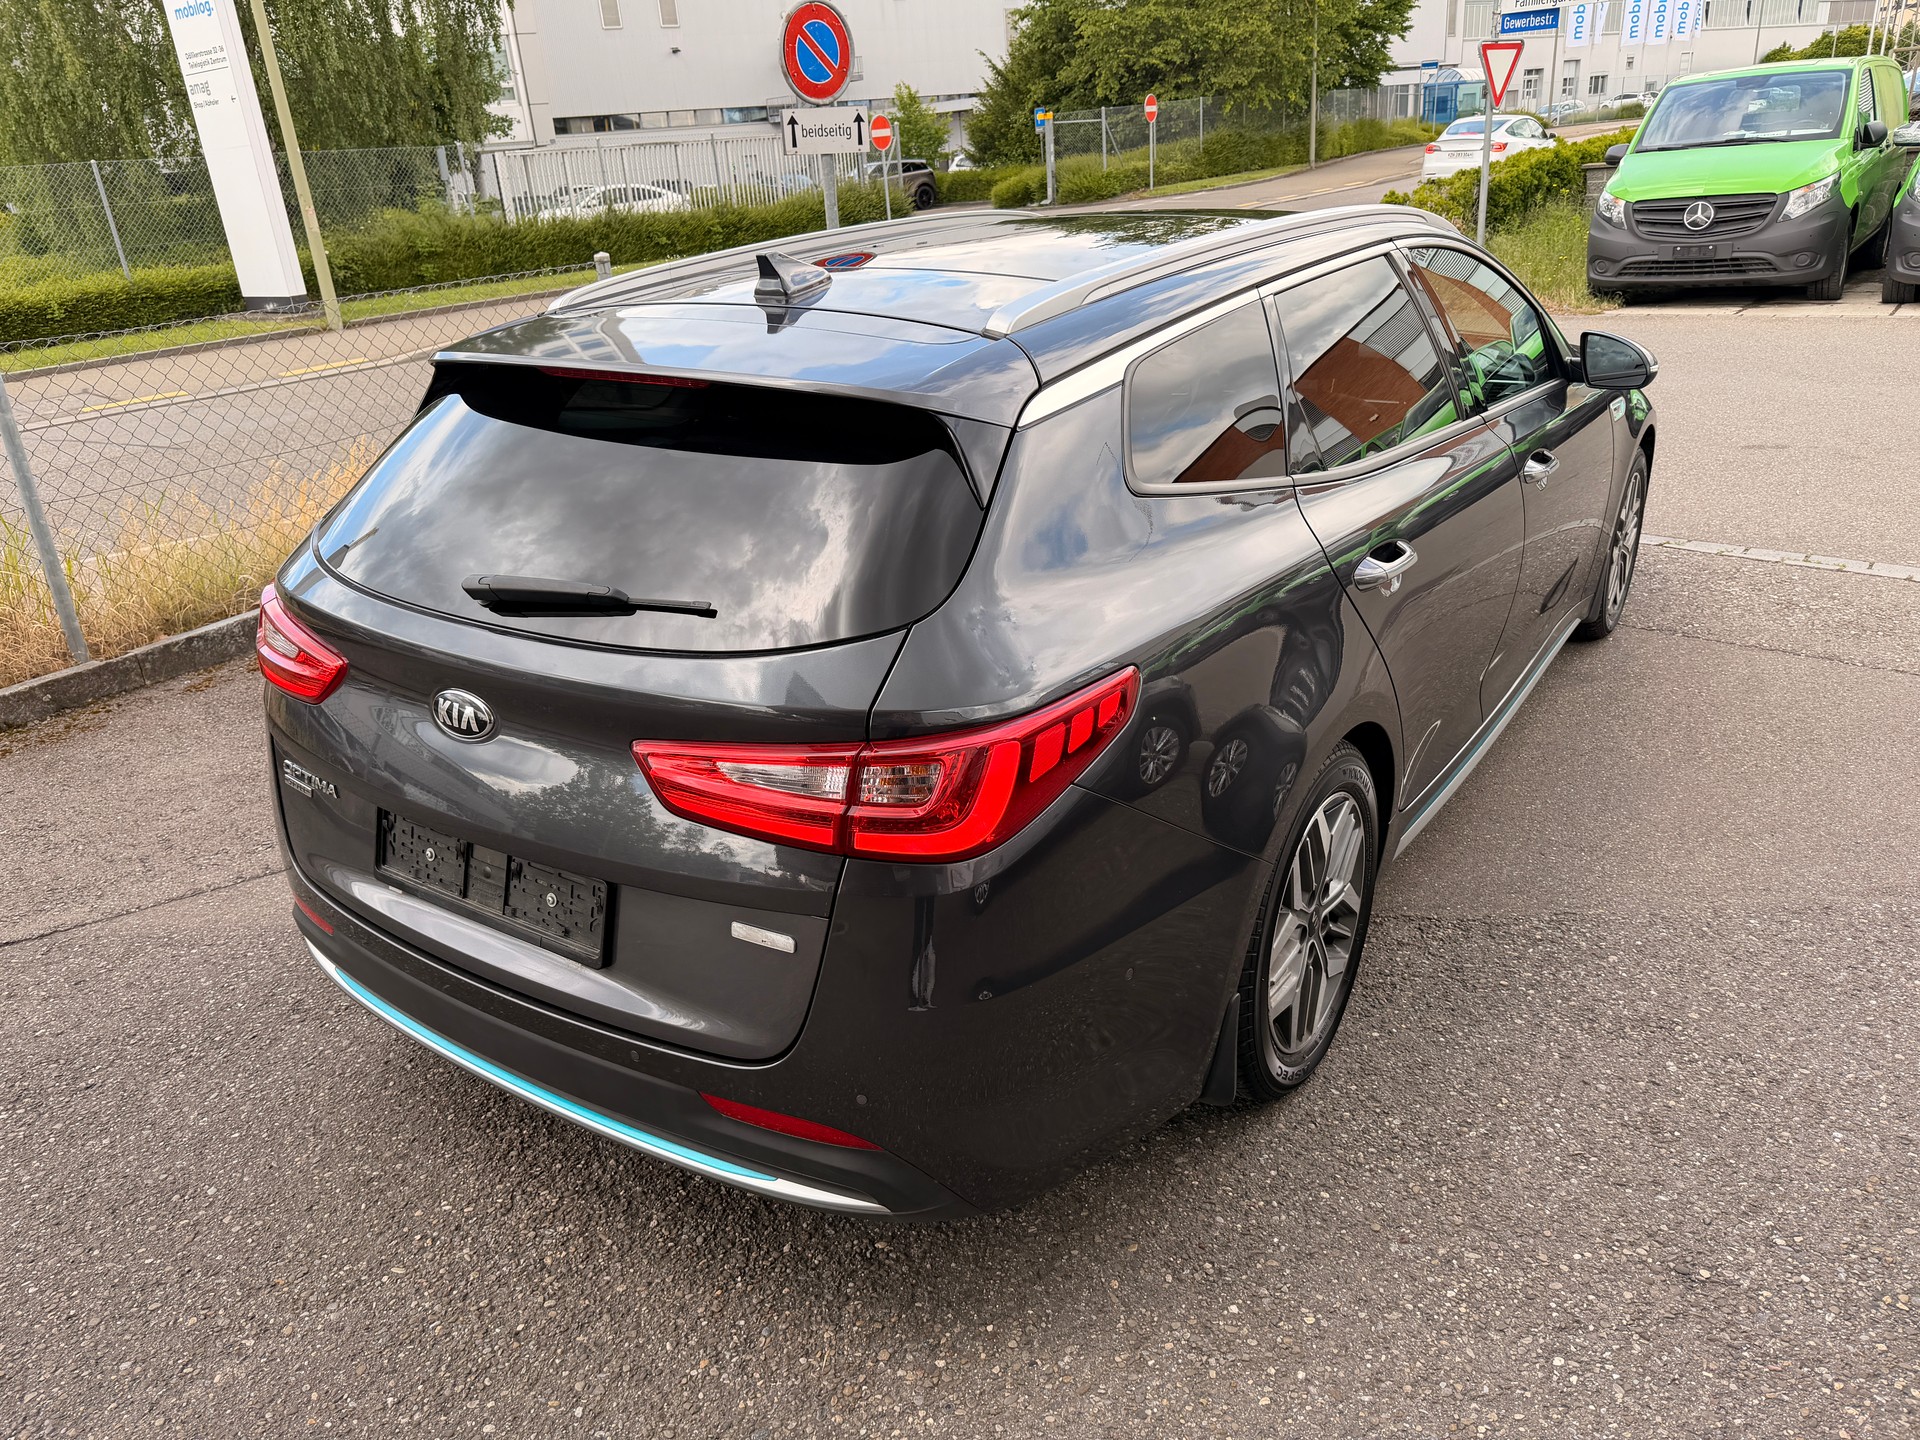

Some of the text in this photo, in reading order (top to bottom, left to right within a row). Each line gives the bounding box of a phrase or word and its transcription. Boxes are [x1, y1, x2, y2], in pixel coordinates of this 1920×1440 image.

[1503, 12, 1556, 29] Gewerbestr.
[210, 56, 227, 65] Zentrum
[189, 80, 211, 96] amag
[801, 123, 852, 140] beidseitig
[438, 697, 479, 733] KIA
[283, 759, 338, 799] OPTIMA
